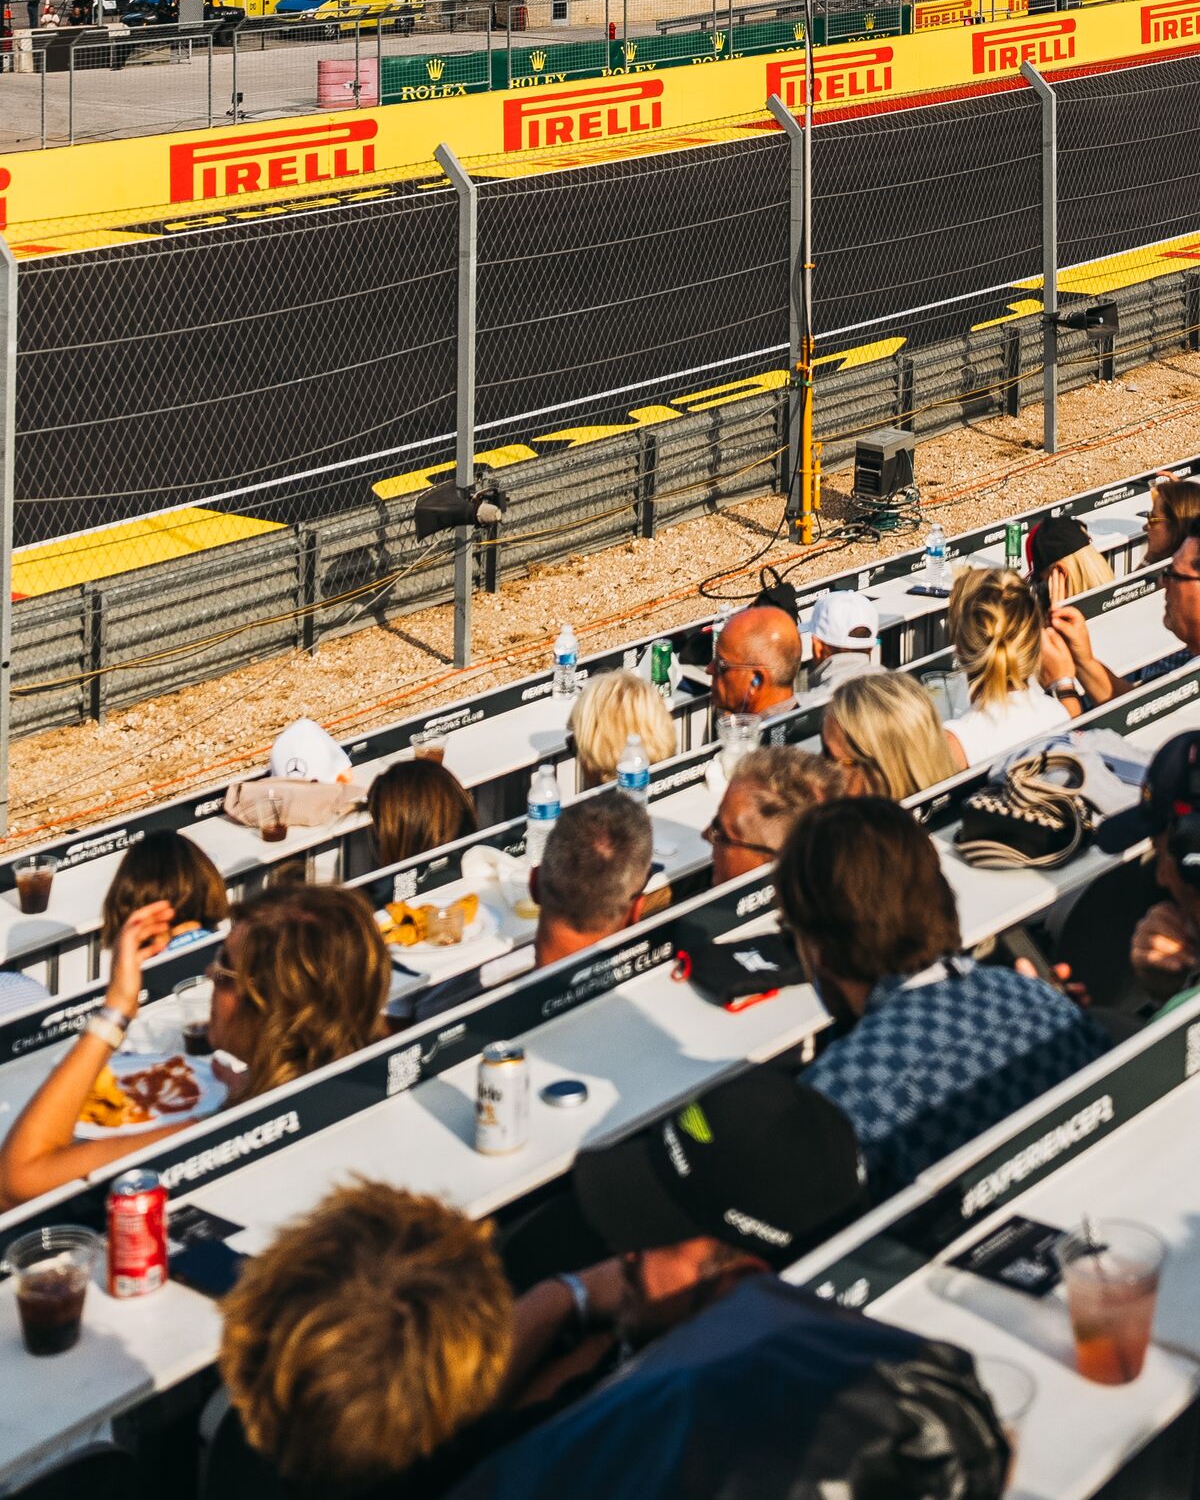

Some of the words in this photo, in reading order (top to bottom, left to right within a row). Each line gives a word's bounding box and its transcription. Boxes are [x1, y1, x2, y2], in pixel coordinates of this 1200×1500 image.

[972, 18, 1077, 75] PIRELLI
[401, 83, 468, 101] ROLEX
[766, 46, 894, 108] PIRELLI
[503, 78, 664, 153] PIRELLI
[170, 118, 379, 203] PIRELLI
[1125, 680, 1200, 727] #EXPERIENCEF1
[634, 940, 674, 973] CLUB
[158, 1109, 301, 1190] XPERIENCEF1
